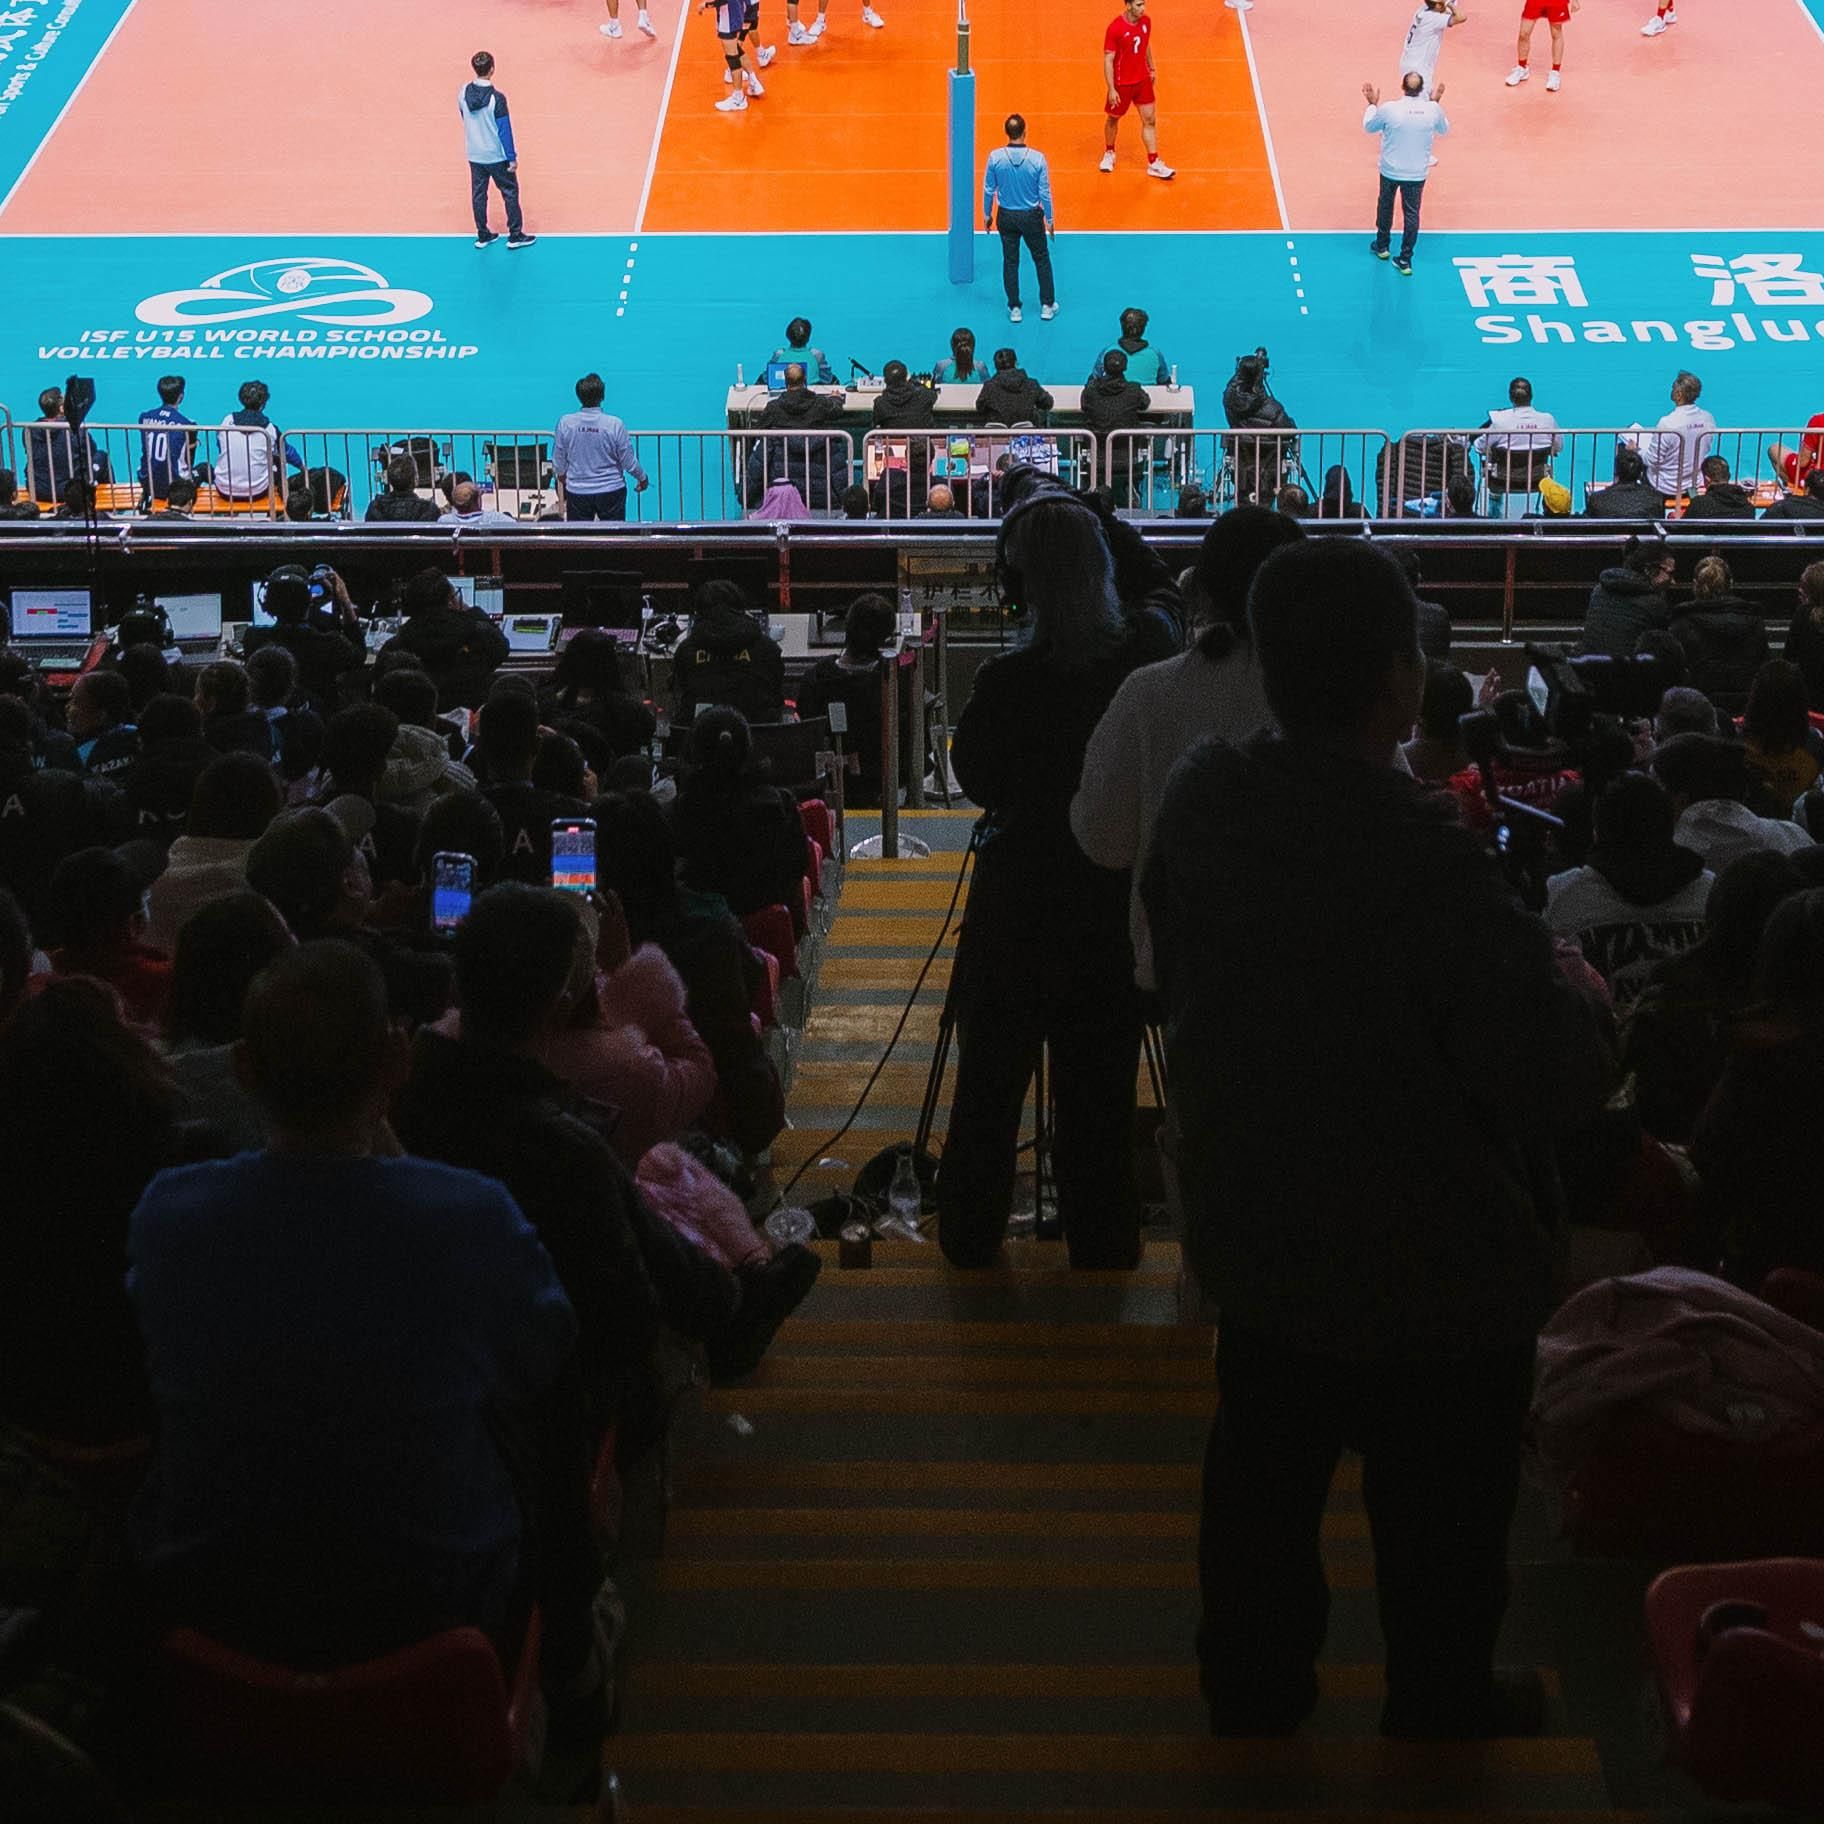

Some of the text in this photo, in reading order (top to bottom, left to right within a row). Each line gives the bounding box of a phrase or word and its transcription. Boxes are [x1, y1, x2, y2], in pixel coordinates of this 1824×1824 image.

[80, 329, 448, 343] ISF U15 WORLD SCHOOL
[38, 345, 479, 360] VOLLEYBALL CHAMPIONSHIP
[146, 431, 168, 462] 10
